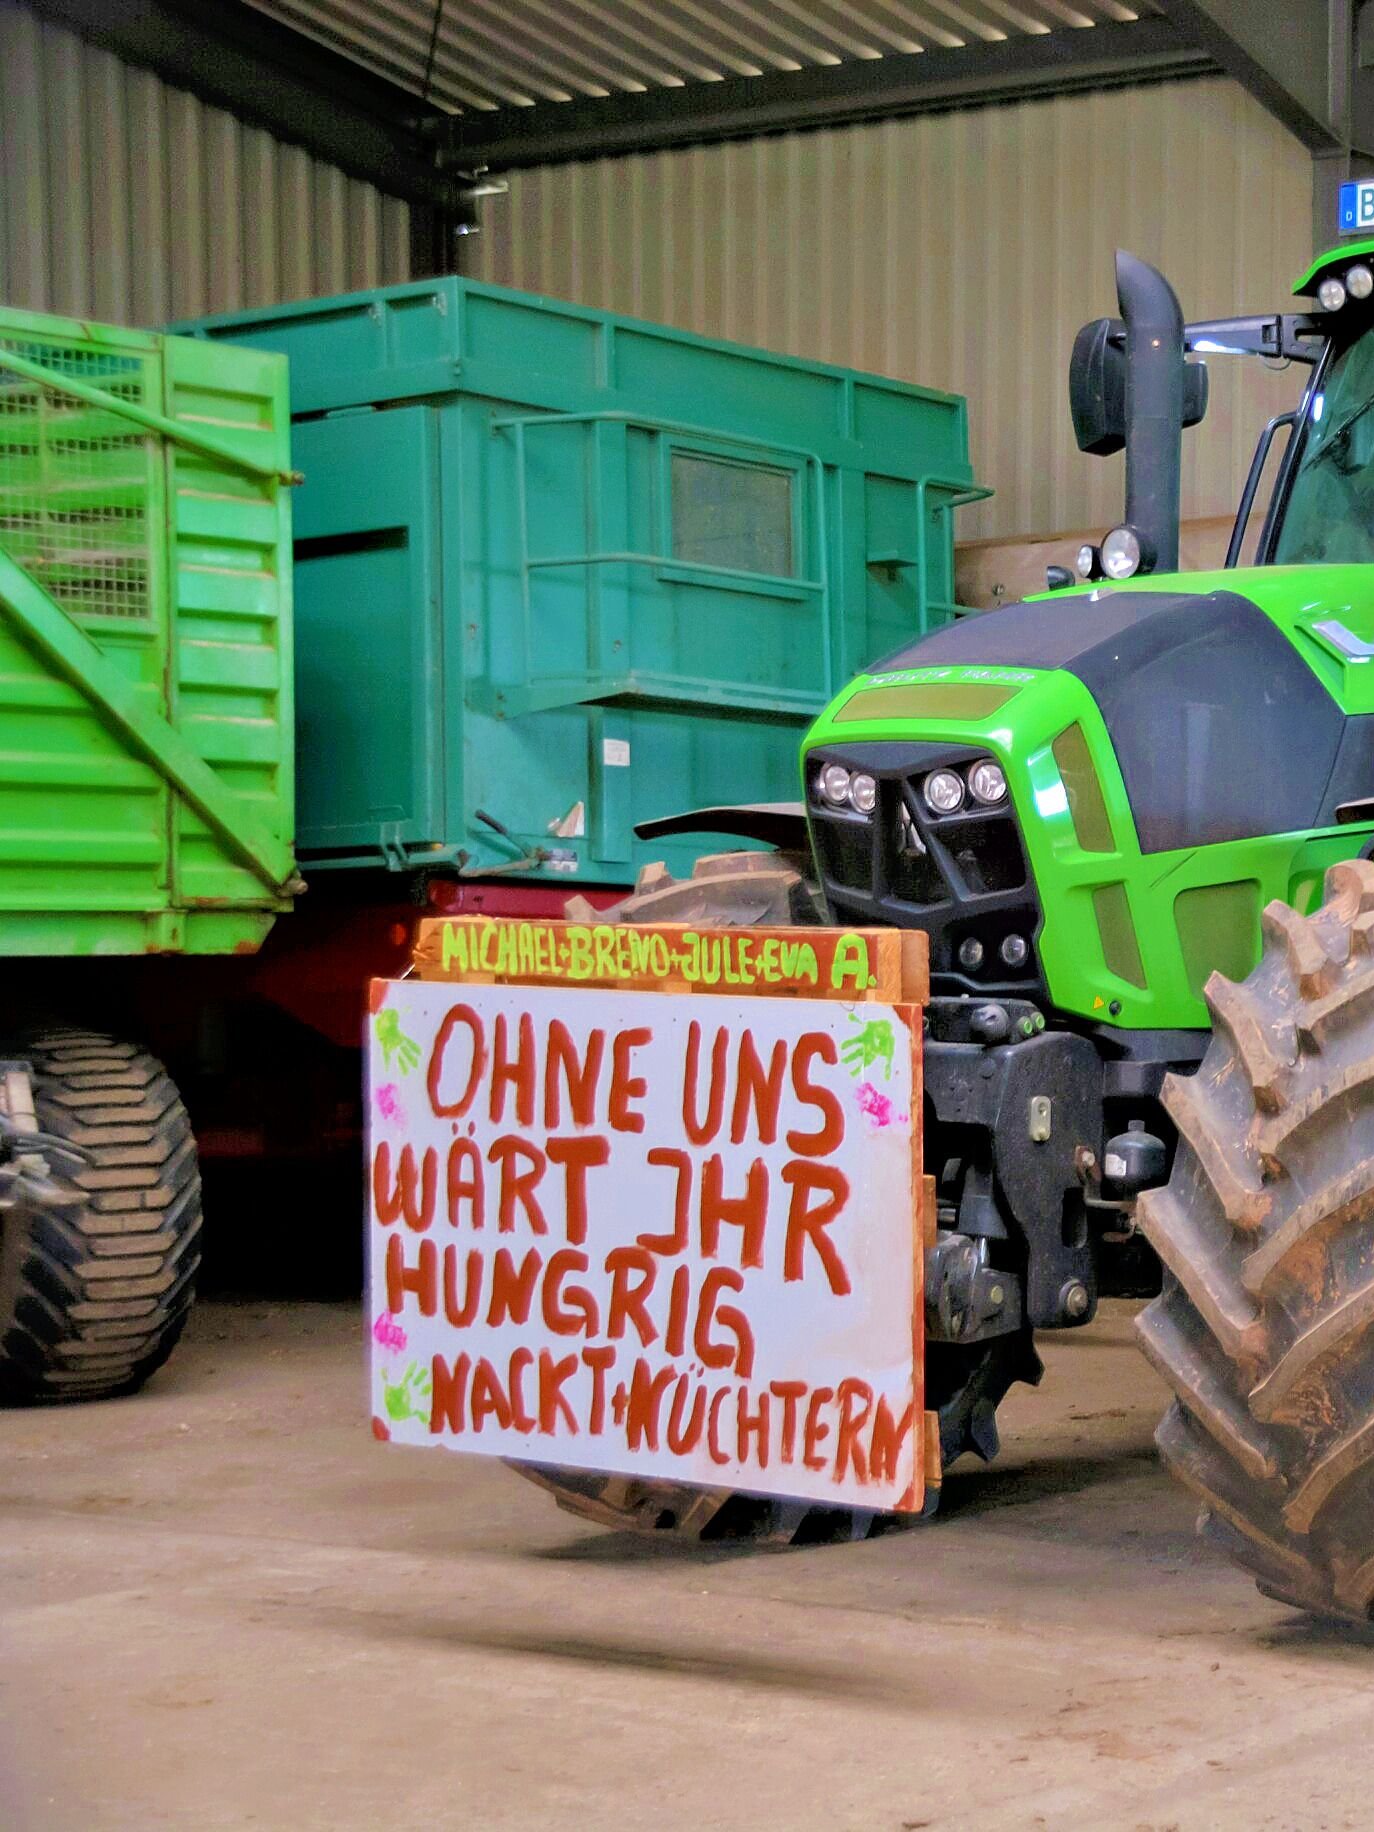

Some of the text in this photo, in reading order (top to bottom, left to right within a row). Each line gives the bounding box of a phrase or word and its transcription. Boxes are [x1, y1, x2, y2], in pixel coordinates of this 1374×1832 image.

[1346, 211, 1353, 222] D
[426, 1004, 845, 1157] OHNE UNS
[373, 1122, 610, 1244] WÄRT
[386, 1232, 756, 1378] HUNGRIG
